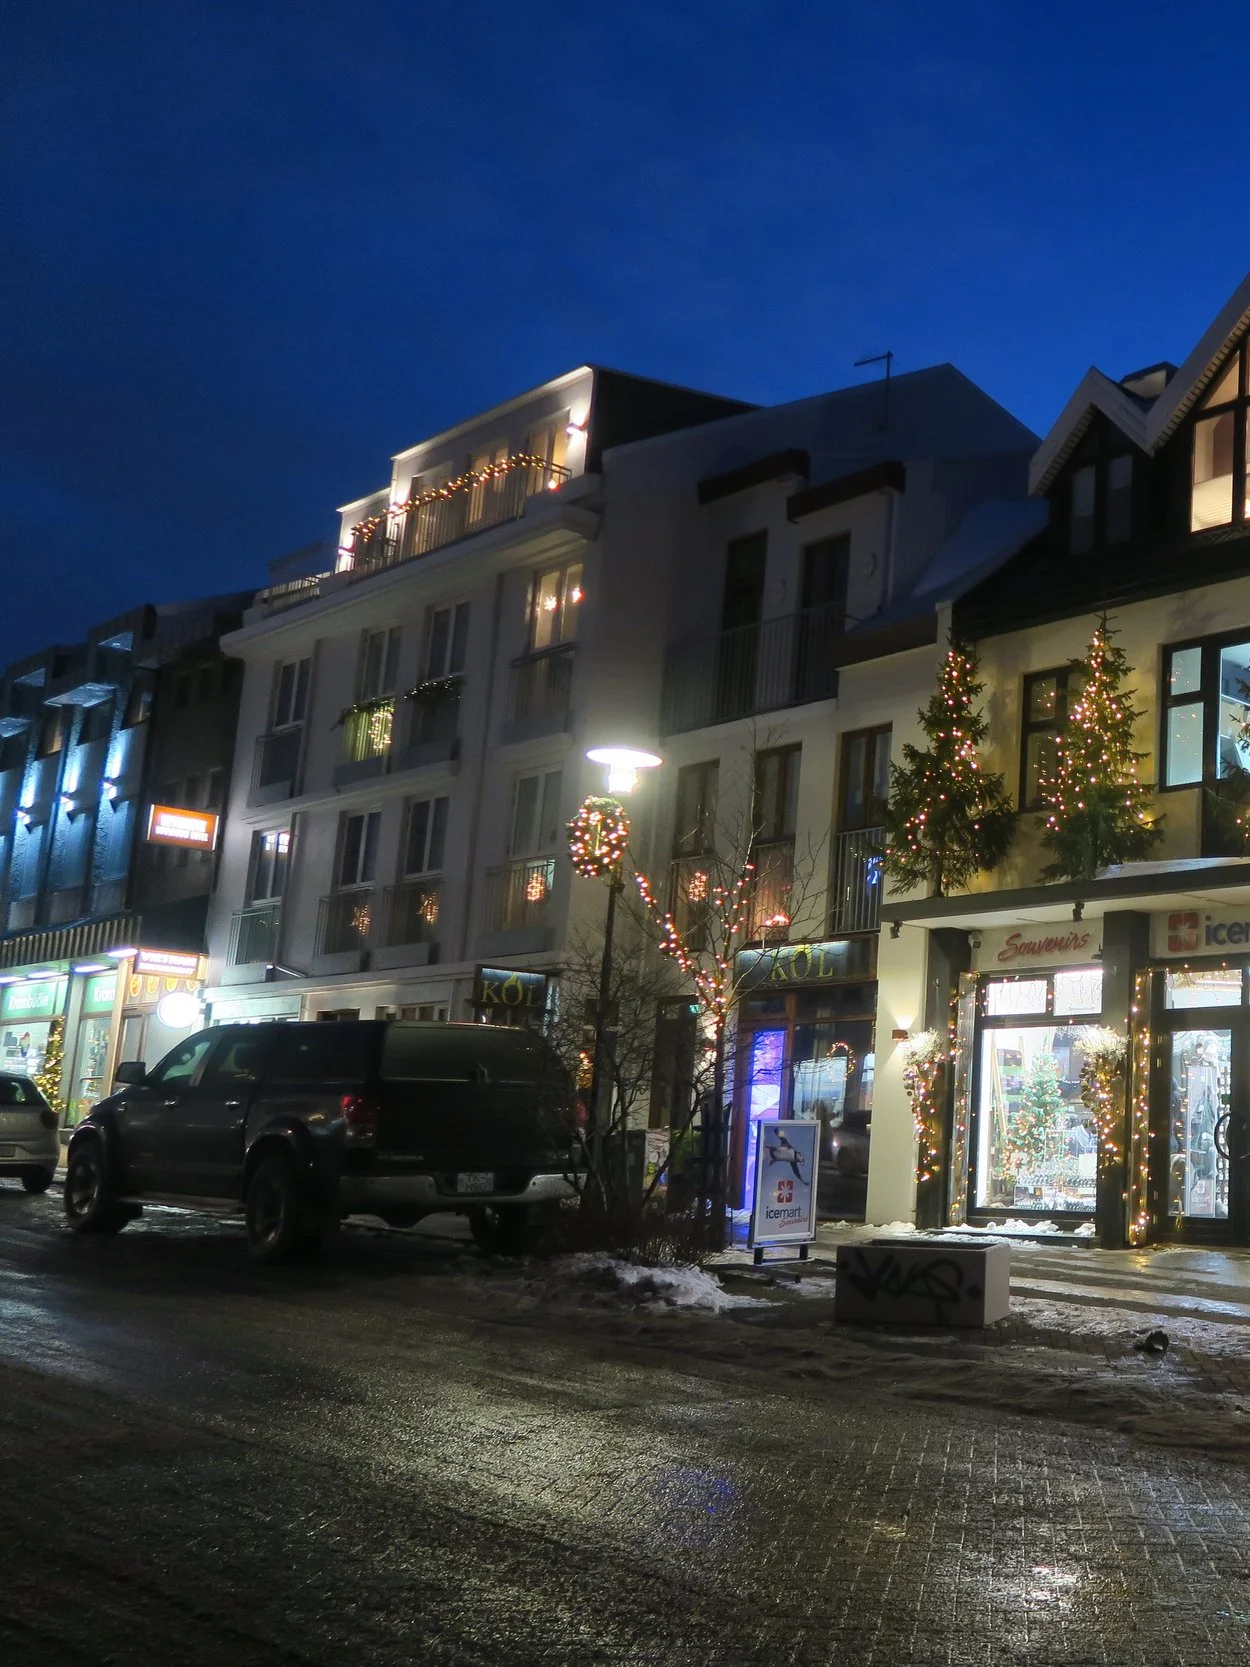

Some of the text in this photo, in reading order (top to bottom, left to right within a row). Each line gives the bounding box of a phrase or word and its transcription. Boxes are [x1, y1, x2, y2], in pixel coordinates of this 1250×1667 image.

[998, 931, 1089, 961] Souvenirs
[769, 945, 833, 981] KOL
[481, 973, 541, 1007] KOL
[766, 1206, 802, 1219] icemart
